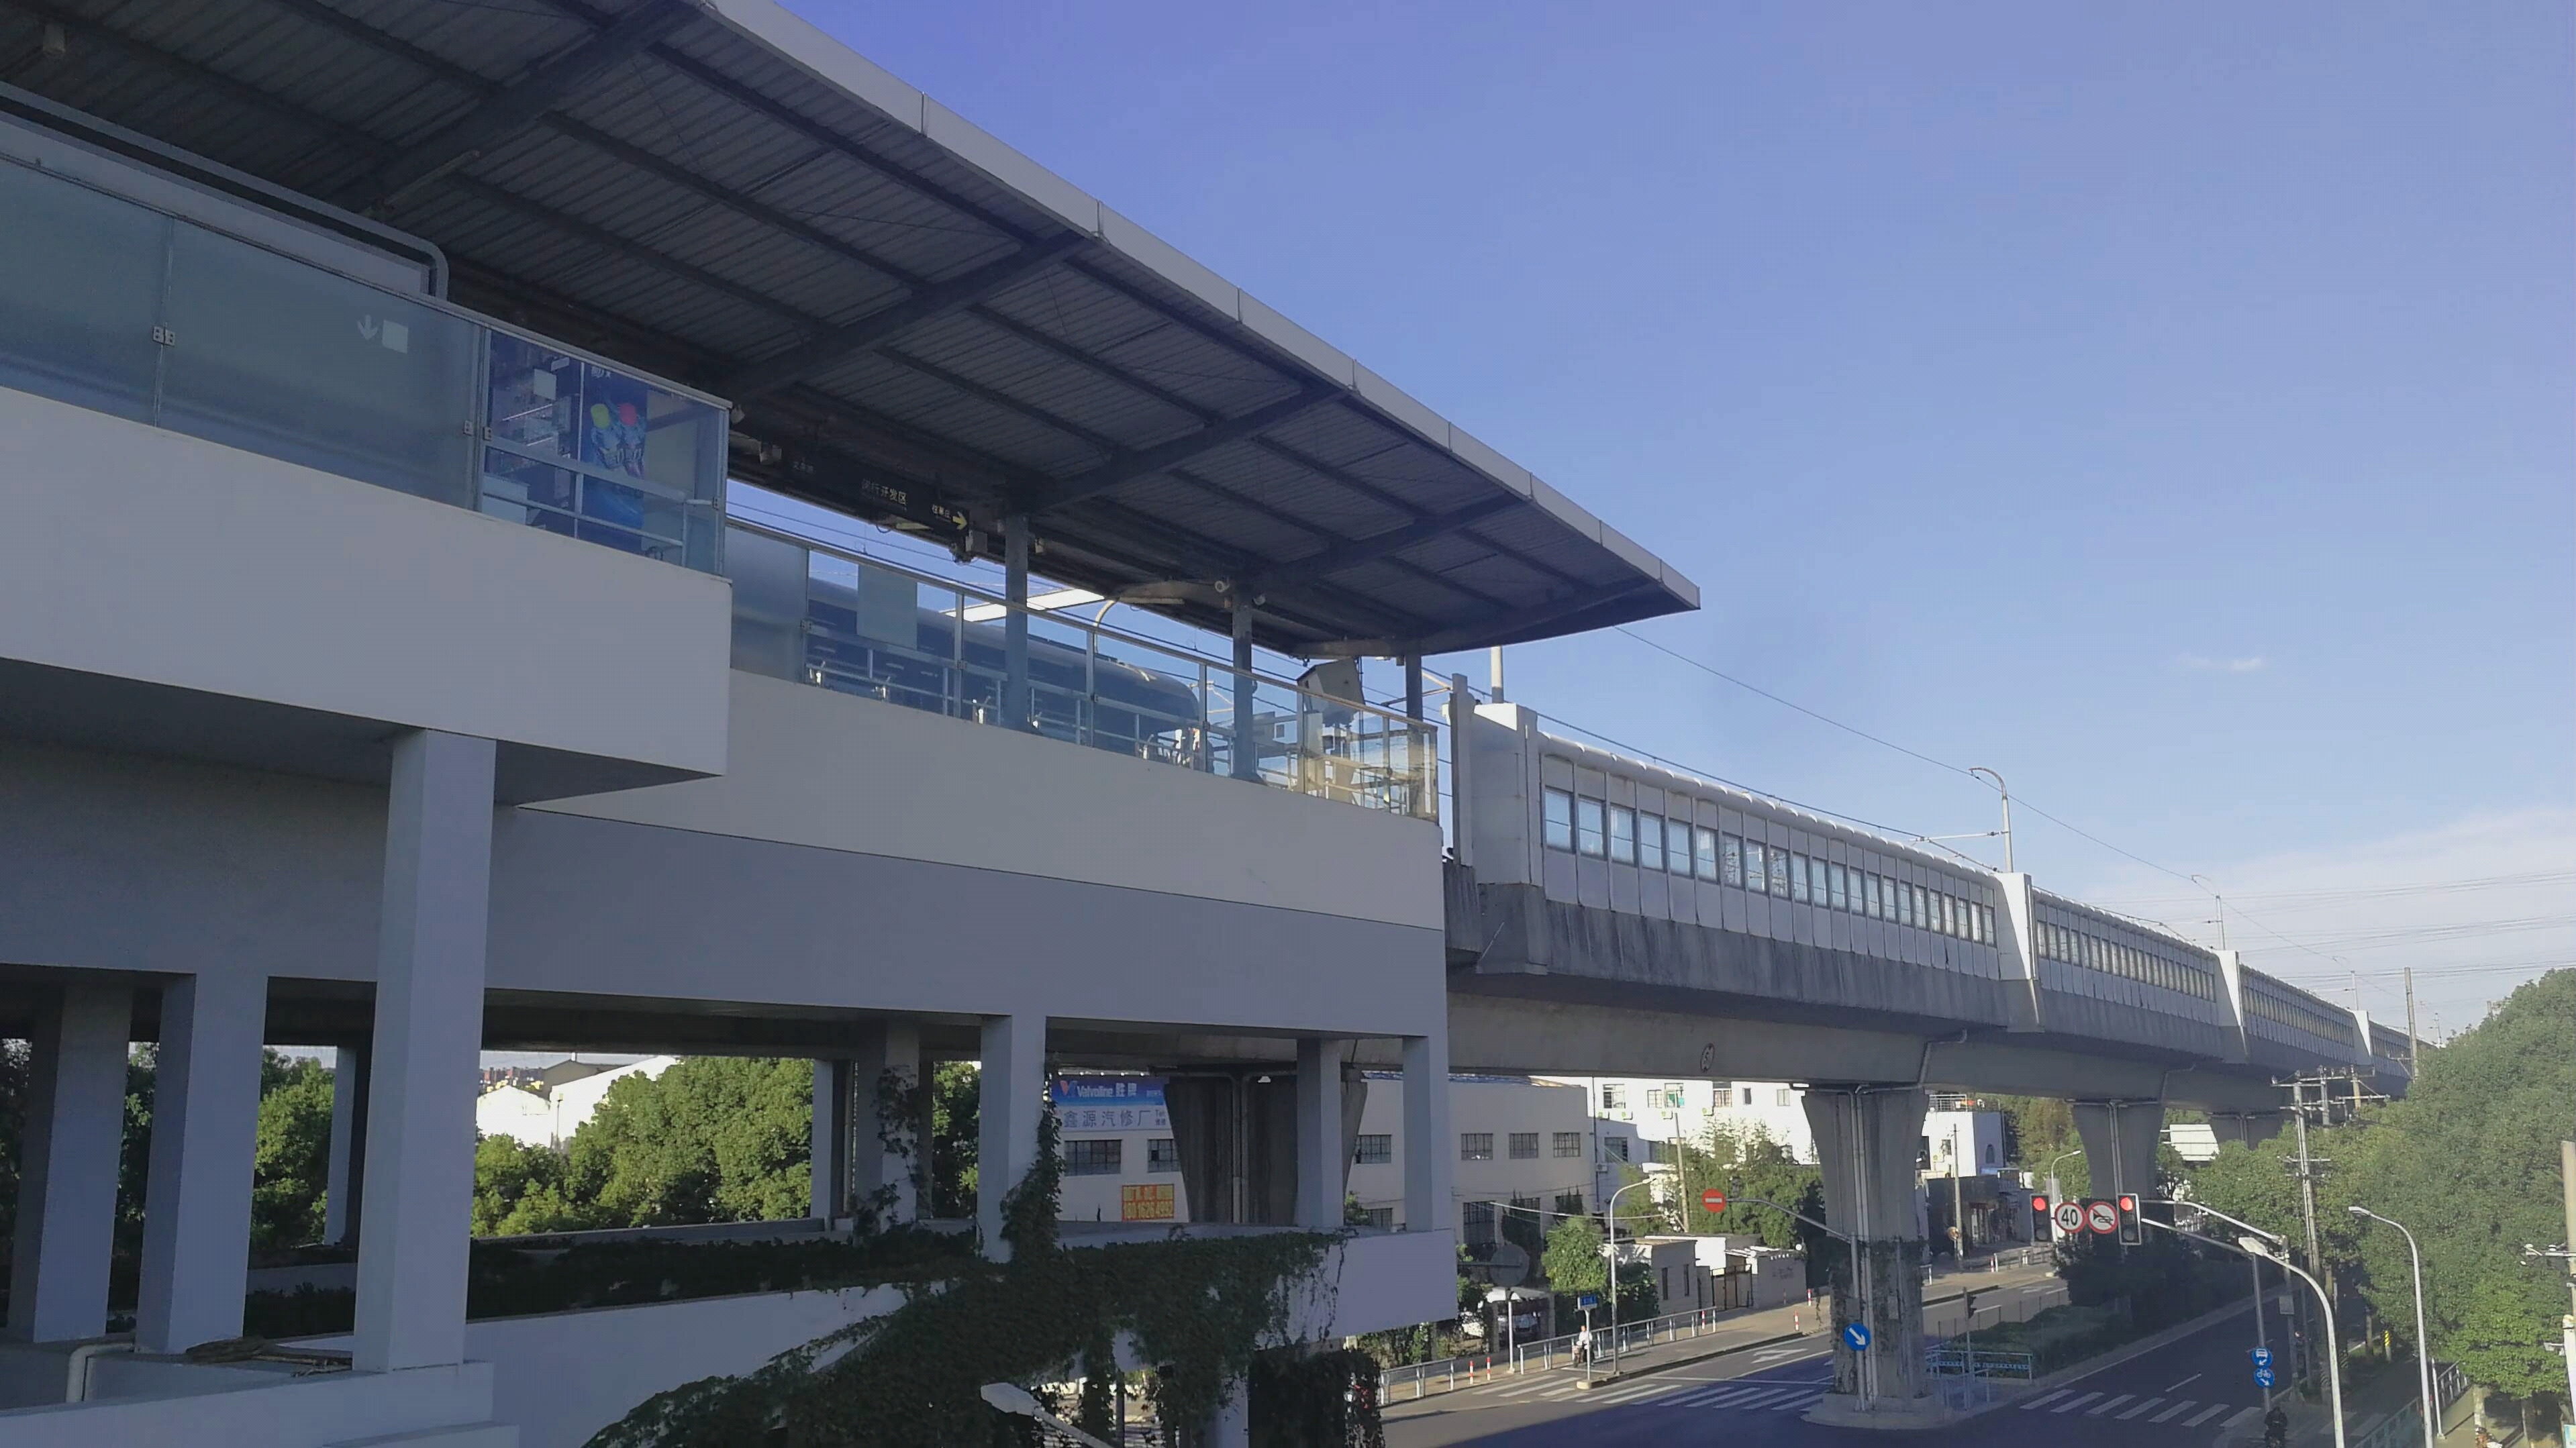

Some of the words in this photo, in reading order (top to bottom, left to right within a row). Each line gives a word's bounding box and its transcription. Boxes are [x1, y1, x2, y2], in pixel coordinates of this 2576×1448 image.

[1077, 1085, 1113, 1098] Valvoline
[1064, 1109, 1151, 1128] 鑫源汽修厂
[2061, 1208, 2078, 1227] 40
